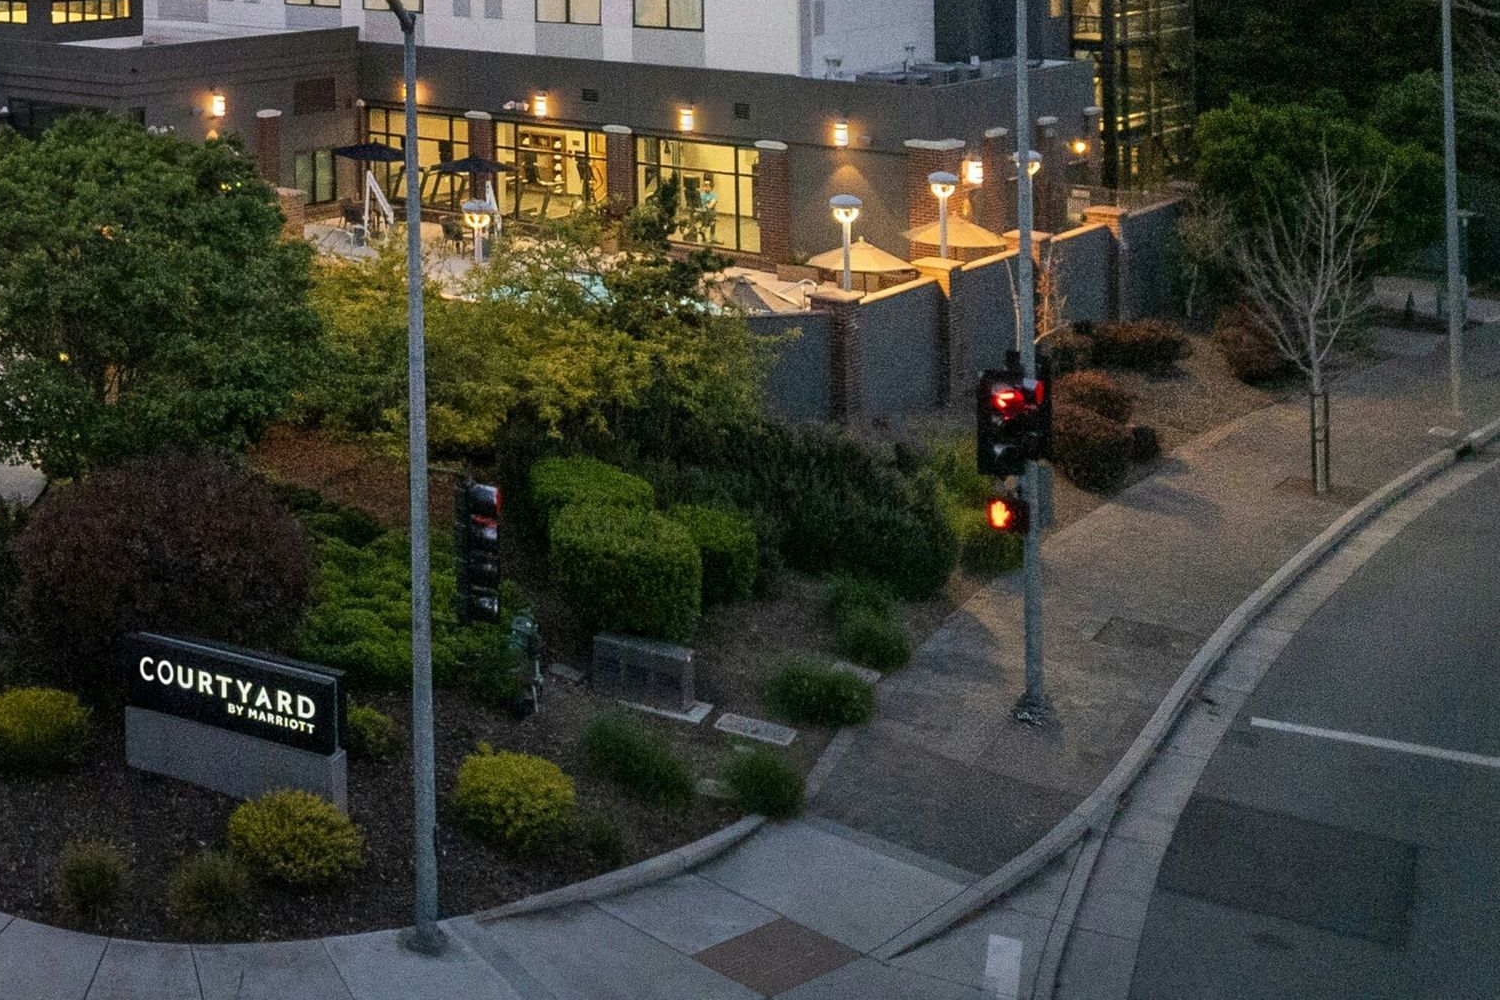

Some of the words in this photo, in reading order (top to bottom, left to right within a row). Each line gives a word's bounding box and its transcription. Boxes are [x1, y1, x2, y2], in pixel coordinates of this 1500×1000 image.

[139, 656, 316, 719] COURTYARD
[227, 702, 244, 716] BY
[248, 708, 315, 734] MARRIOTT
